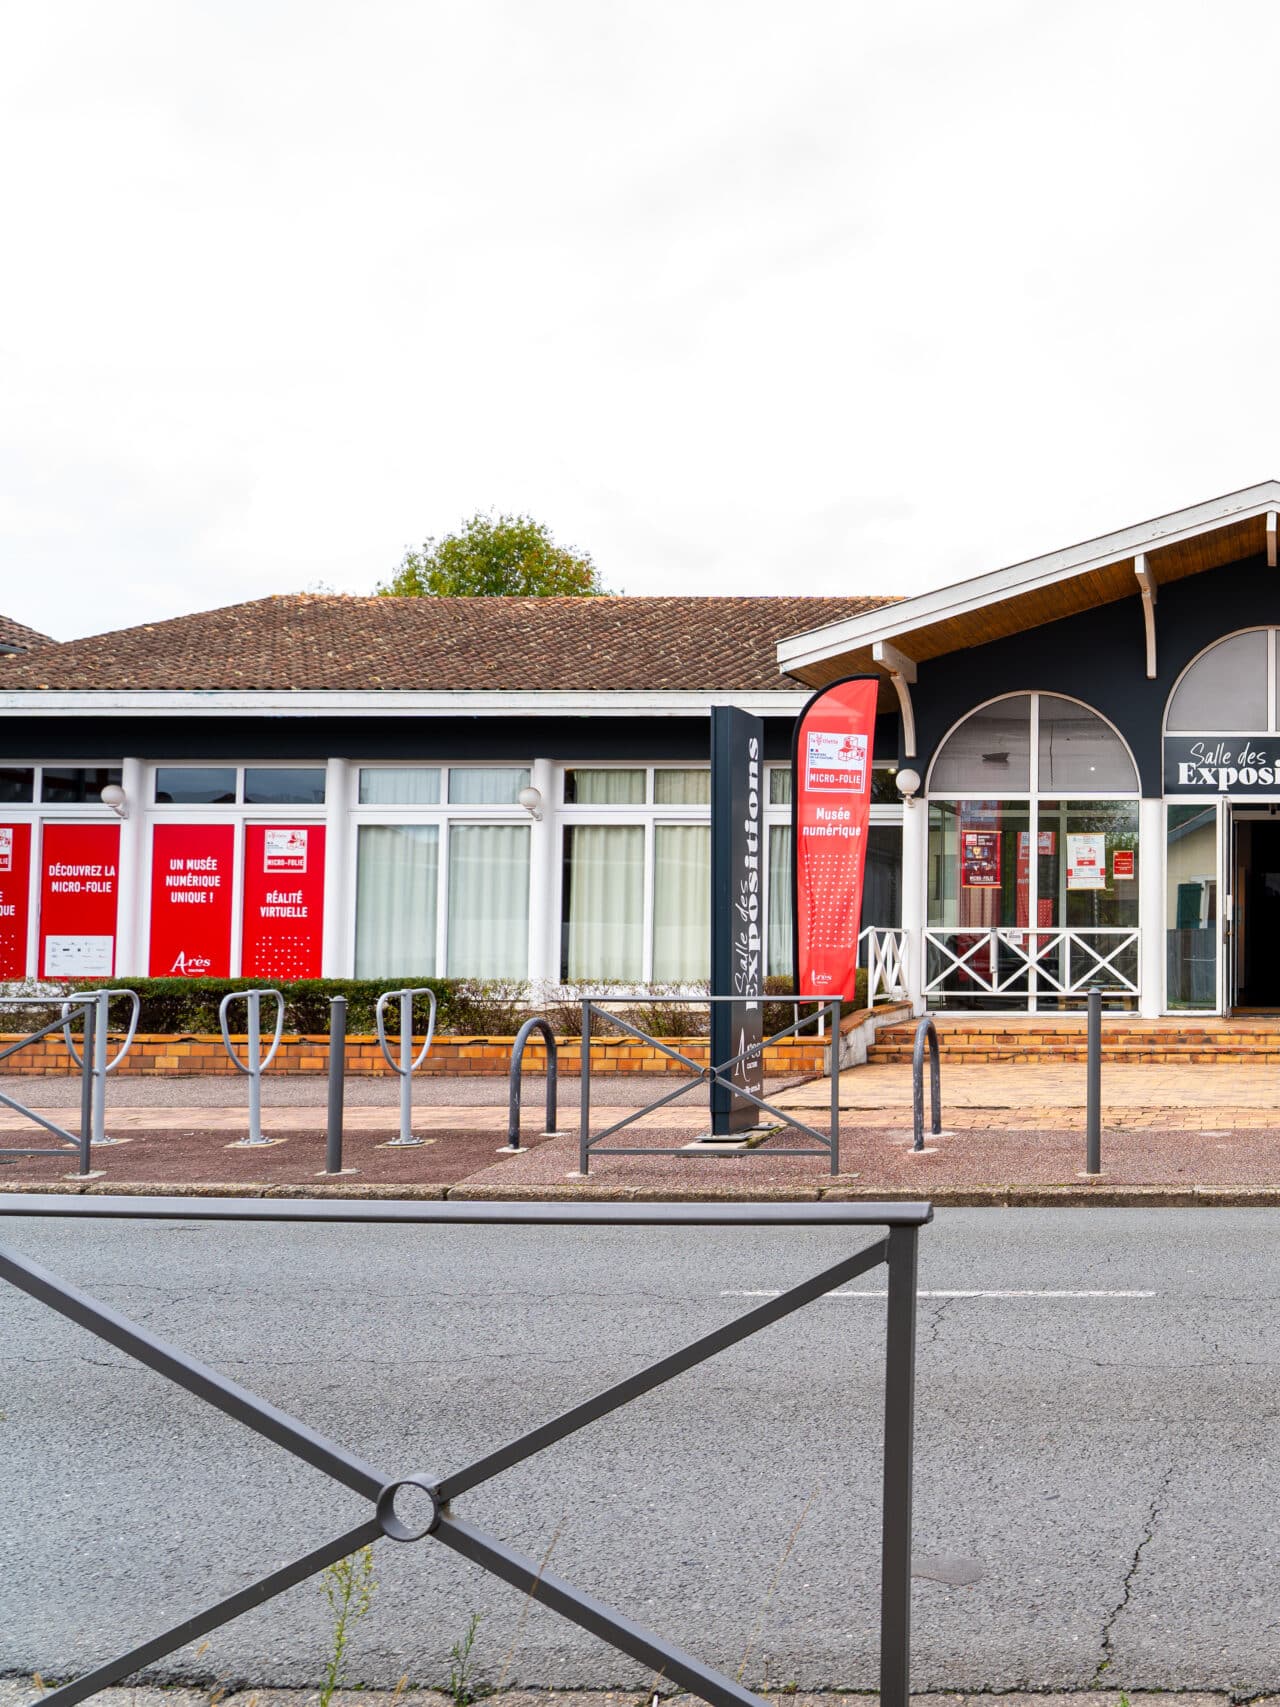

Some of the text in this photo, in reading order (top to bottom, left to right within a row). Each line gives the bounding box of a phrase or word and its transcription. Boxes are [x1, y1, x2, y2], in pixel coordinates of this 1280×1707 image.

[1190, 741, 1267, 767] Salle des
[809, 773, 862, 784] MICRO-FOLIE
[816, 807, 851, 820] Musée
[802, 824, 862, 839] numérique
[48, 862, 116, 876] DÉCOUVREZ LA
[169, 856, 218, 871] UN MUSÉE
[267, 859, 305, 867] MICRO-FOLIE
[165, 873, 221, 887] NUMÉRIQUE
[745, 737, 761, 1011] Expositions
[51, 881, 112, 893] MICRO-FOLIE
[170, 892, 214, 904] UNIQUE !
[266, 889, 303, 904] RÉALITÉ
[259, 906, 308, 918] VIRTUELLE
[734, 880, 748, 993] Salle des
[170, 951, 211, 977] Arès
